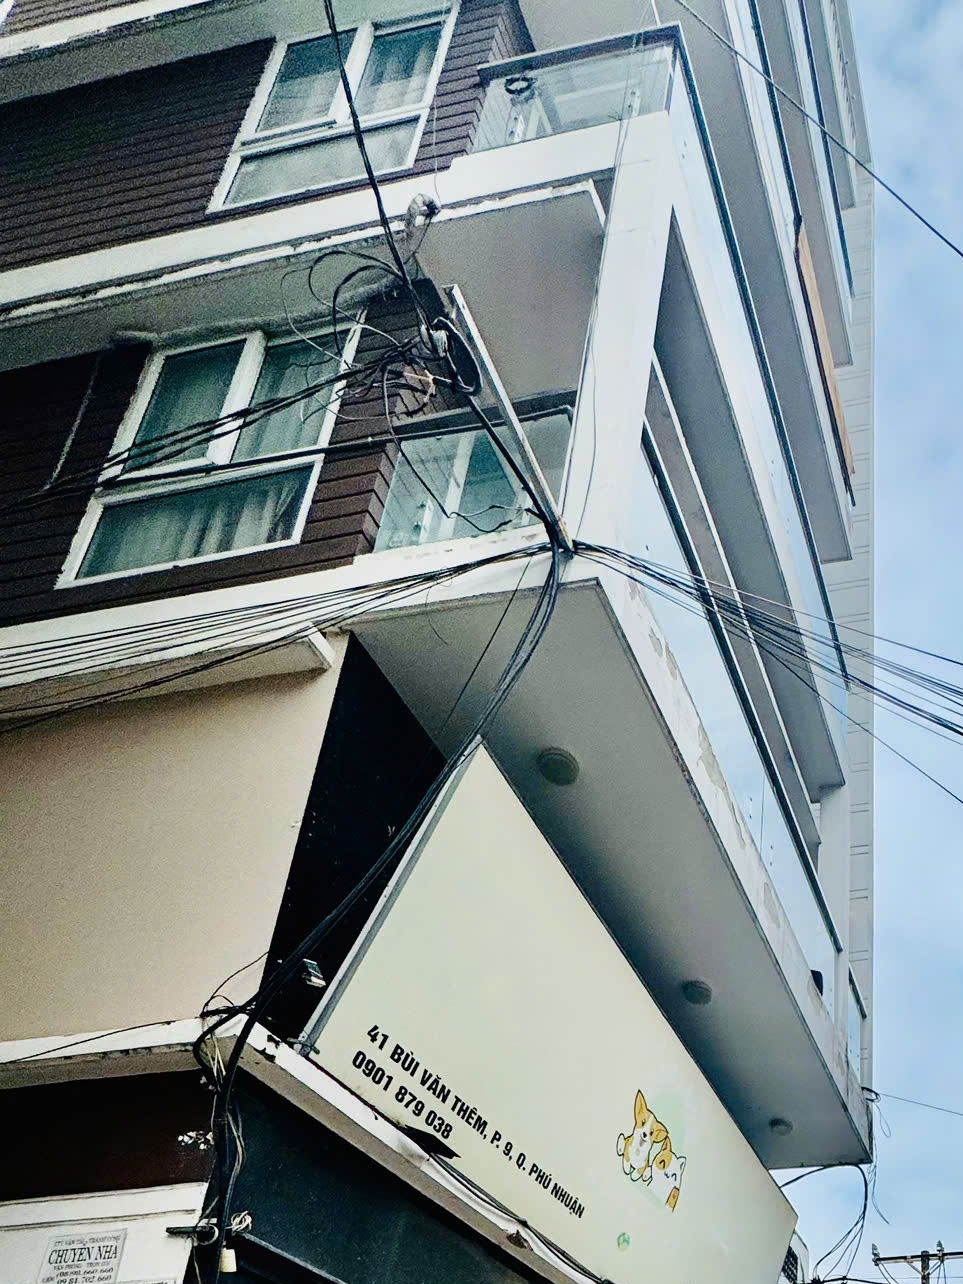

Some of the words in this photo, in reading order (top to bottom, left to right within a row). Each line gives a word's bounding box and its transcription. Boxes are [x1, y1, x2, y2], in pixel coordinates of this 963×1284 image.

[352, 1050, 394, 1092] 0901
[394, 1085, 425, 1118] 879
[424, 1110, 453, 1140] 038
[367, 1024, 389, 1051] 41
[389, 1043, 420, 1077] BÙI
[419, 1068, 452, 1104] VĂN
[450, 1094, 490, 1140] THÊM,
[490, 1130, 502, 1149] P.
[503, 1141, 514, 1161] 9,
[515, 1152, 527, 1171] Q.
[528, 1163, 553, 1190] PHÚ
[550, 1184, 586, 1219] NHUẬN
